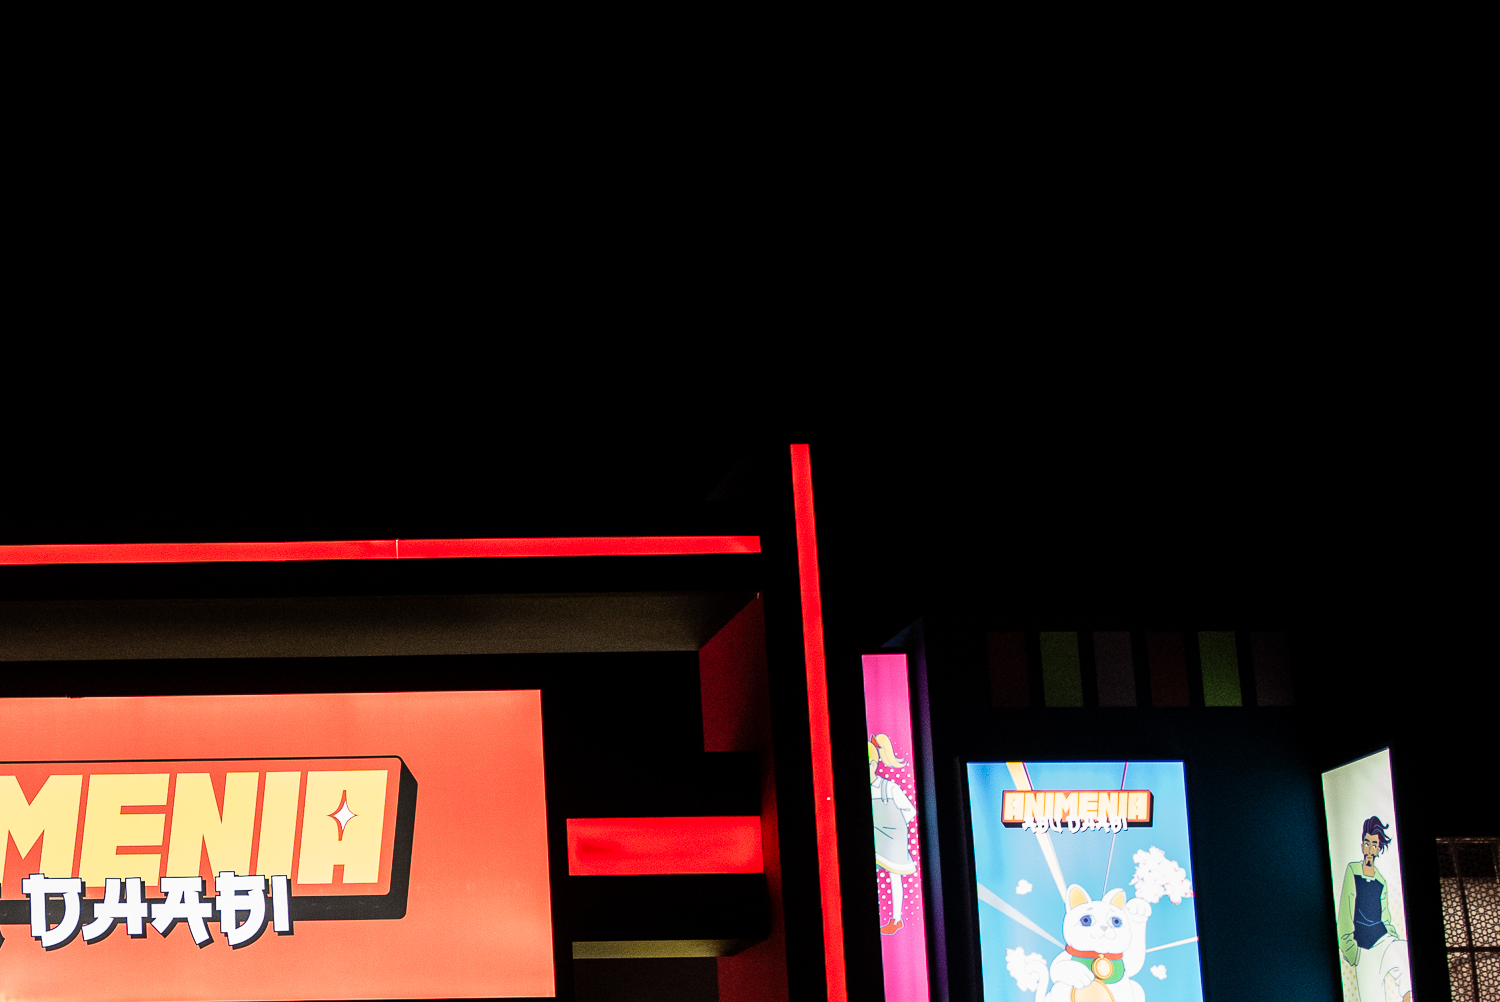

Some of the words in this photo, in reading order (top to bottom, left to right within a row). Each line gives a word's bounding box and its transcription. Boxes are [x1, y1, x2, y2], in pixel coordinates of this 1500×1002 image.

[1005, 791, 1148, 821] ANIMENIA
[1022, 816, 1063, 834] ABU
[1066, 815, 1128, 834] DHABI
[22, 871, 294, 950] DHABI
